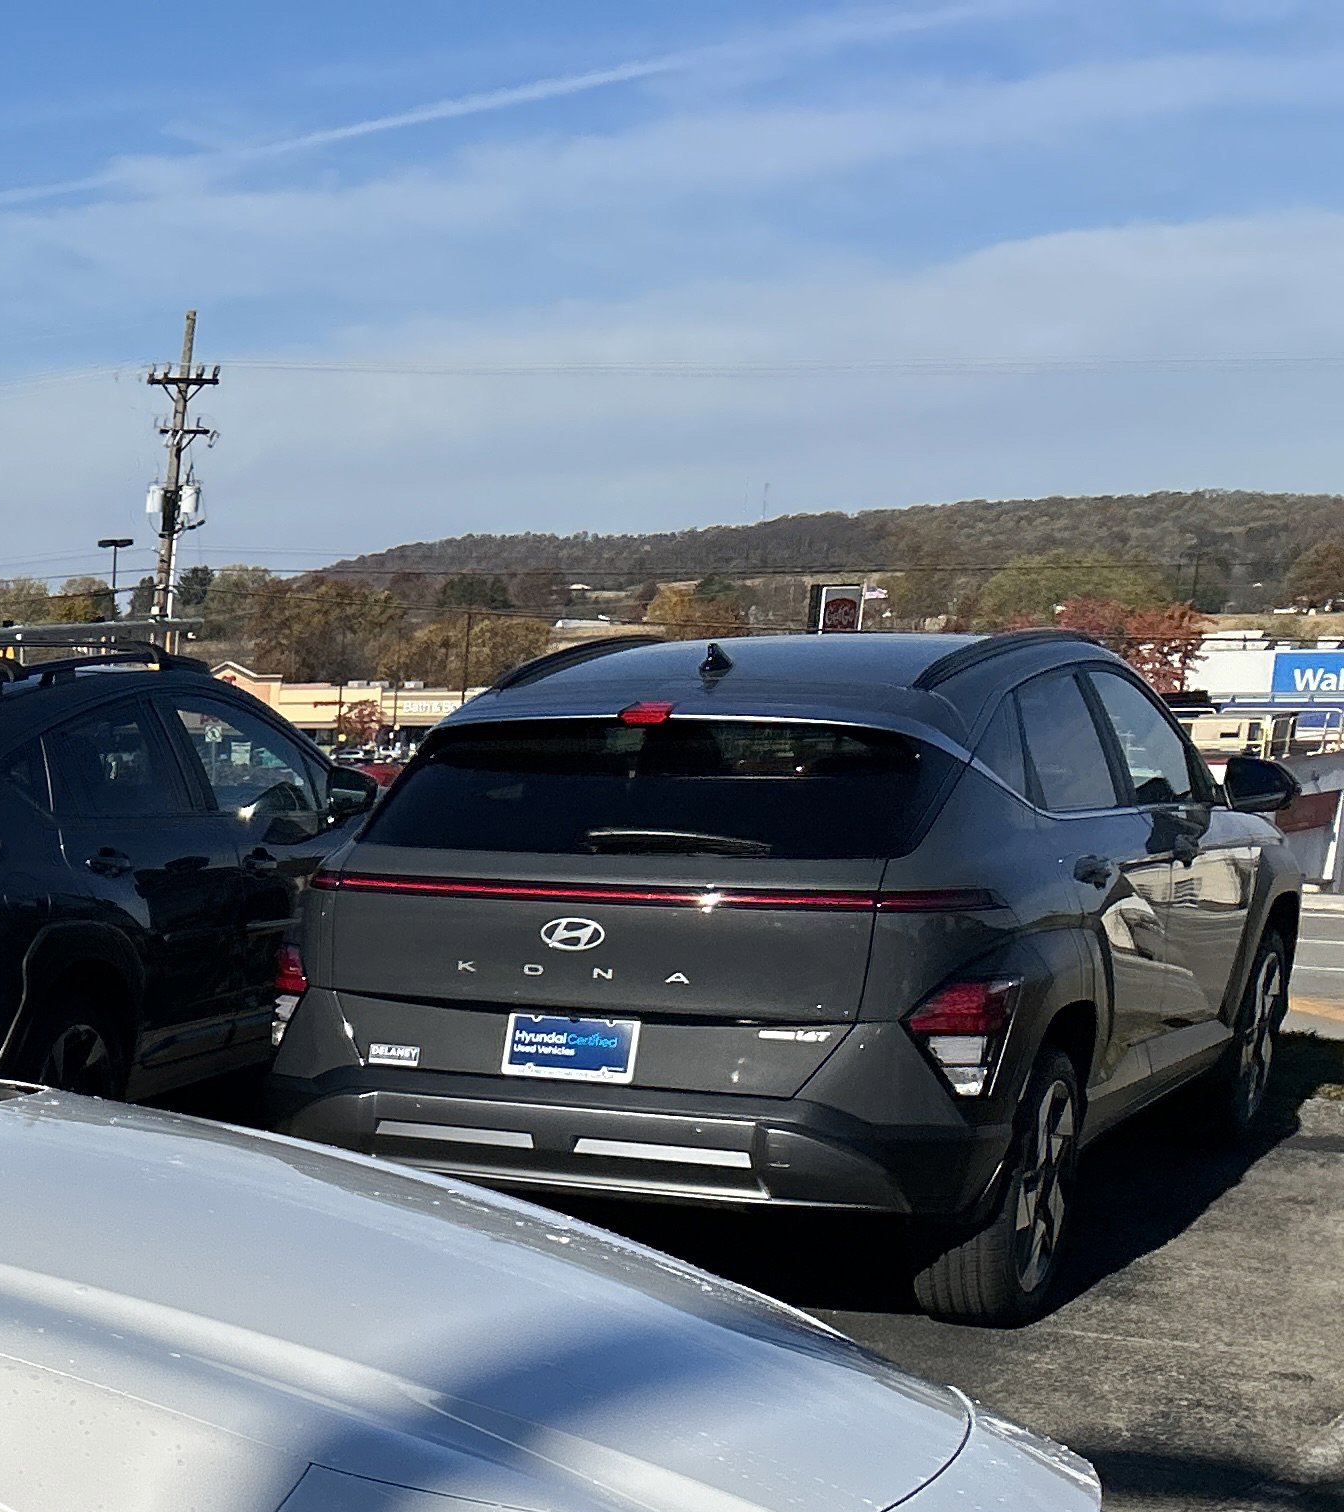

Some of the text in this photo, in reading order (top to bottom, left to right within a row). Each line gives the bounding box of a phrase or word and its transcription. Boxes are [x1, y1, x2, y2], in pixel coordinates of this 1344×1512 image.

[457, 960, 690, 985] KONA
[514, 1029, 618, 1048] Hyundai Certified
[371, 1045, 418, 1060] DELANEY
[513, 1043, 576, 1056] Used Vehicles
